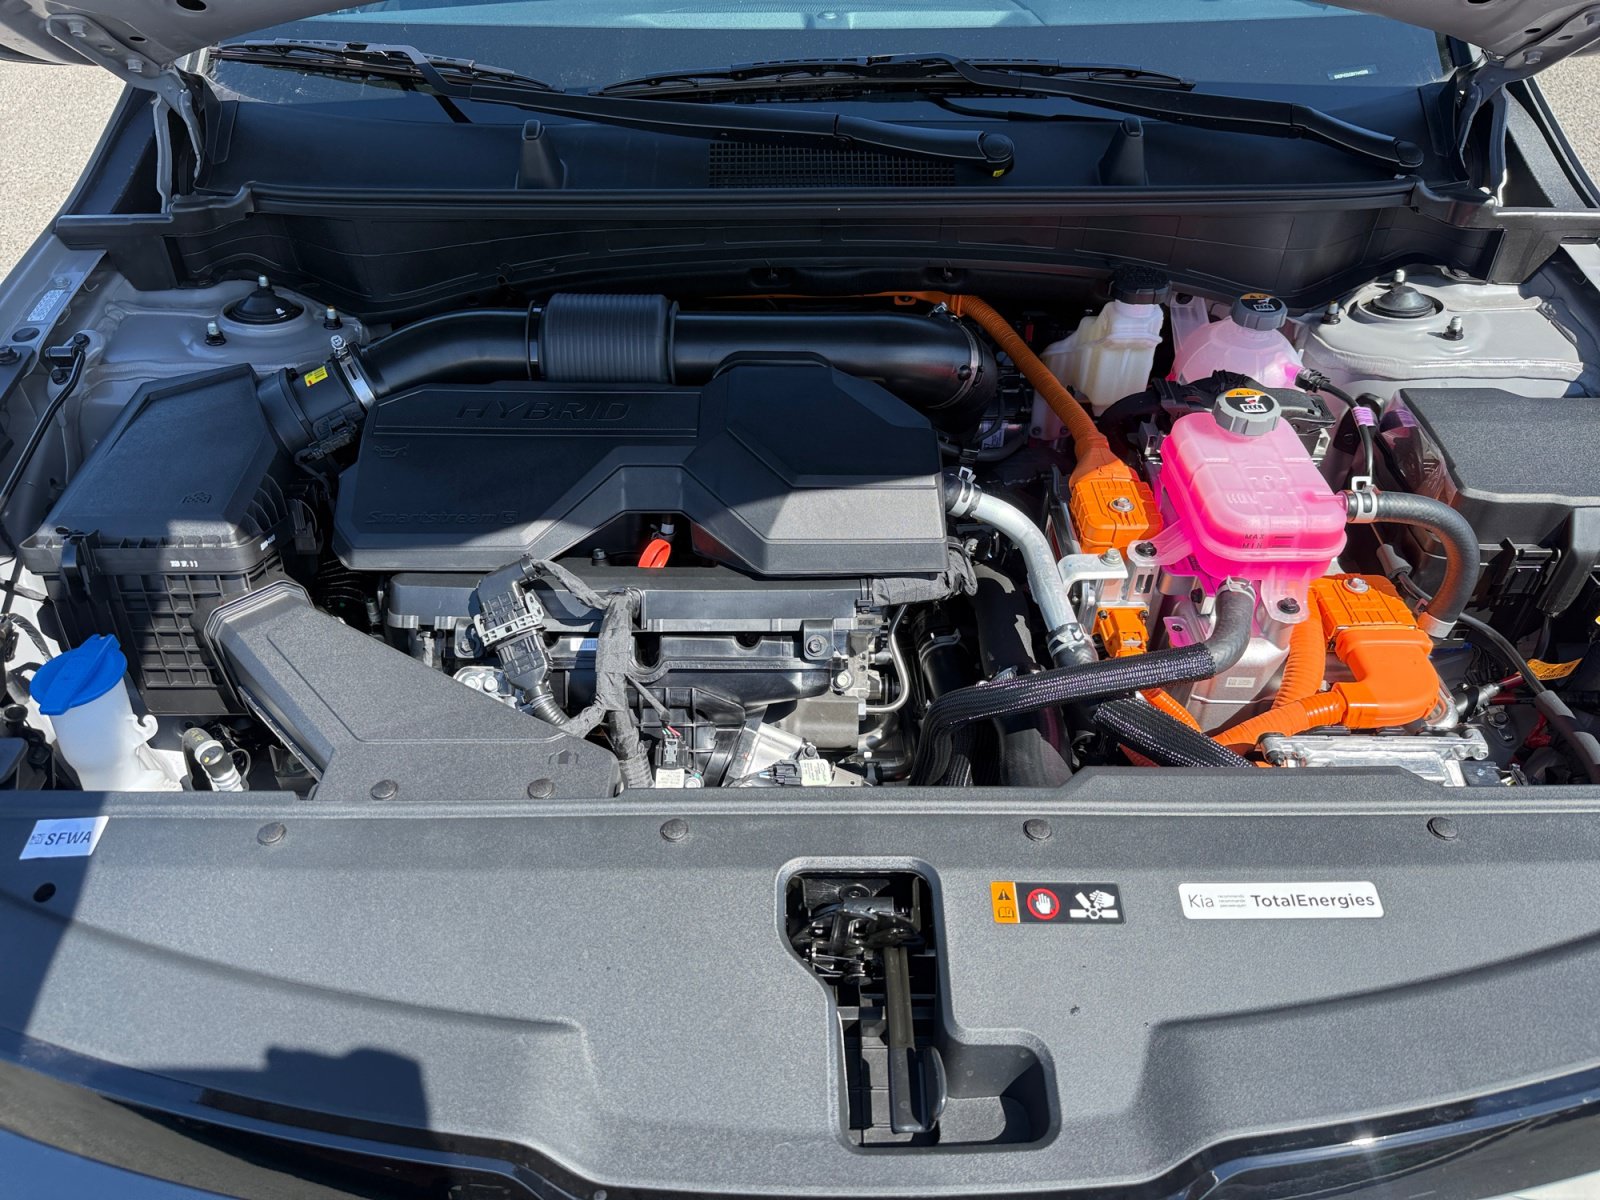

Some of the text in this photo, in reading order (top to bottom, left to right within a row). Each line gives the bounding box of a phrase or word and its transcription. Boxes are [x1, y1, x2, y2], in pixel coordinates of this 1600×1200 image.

[455, 400, 632, 421] HYBRID
[364, 510, 498, 525] Smartstream
[44, 831, 92, 846] SFWA
[1188, 893, 1376, 909] Kia TotalEnergies
